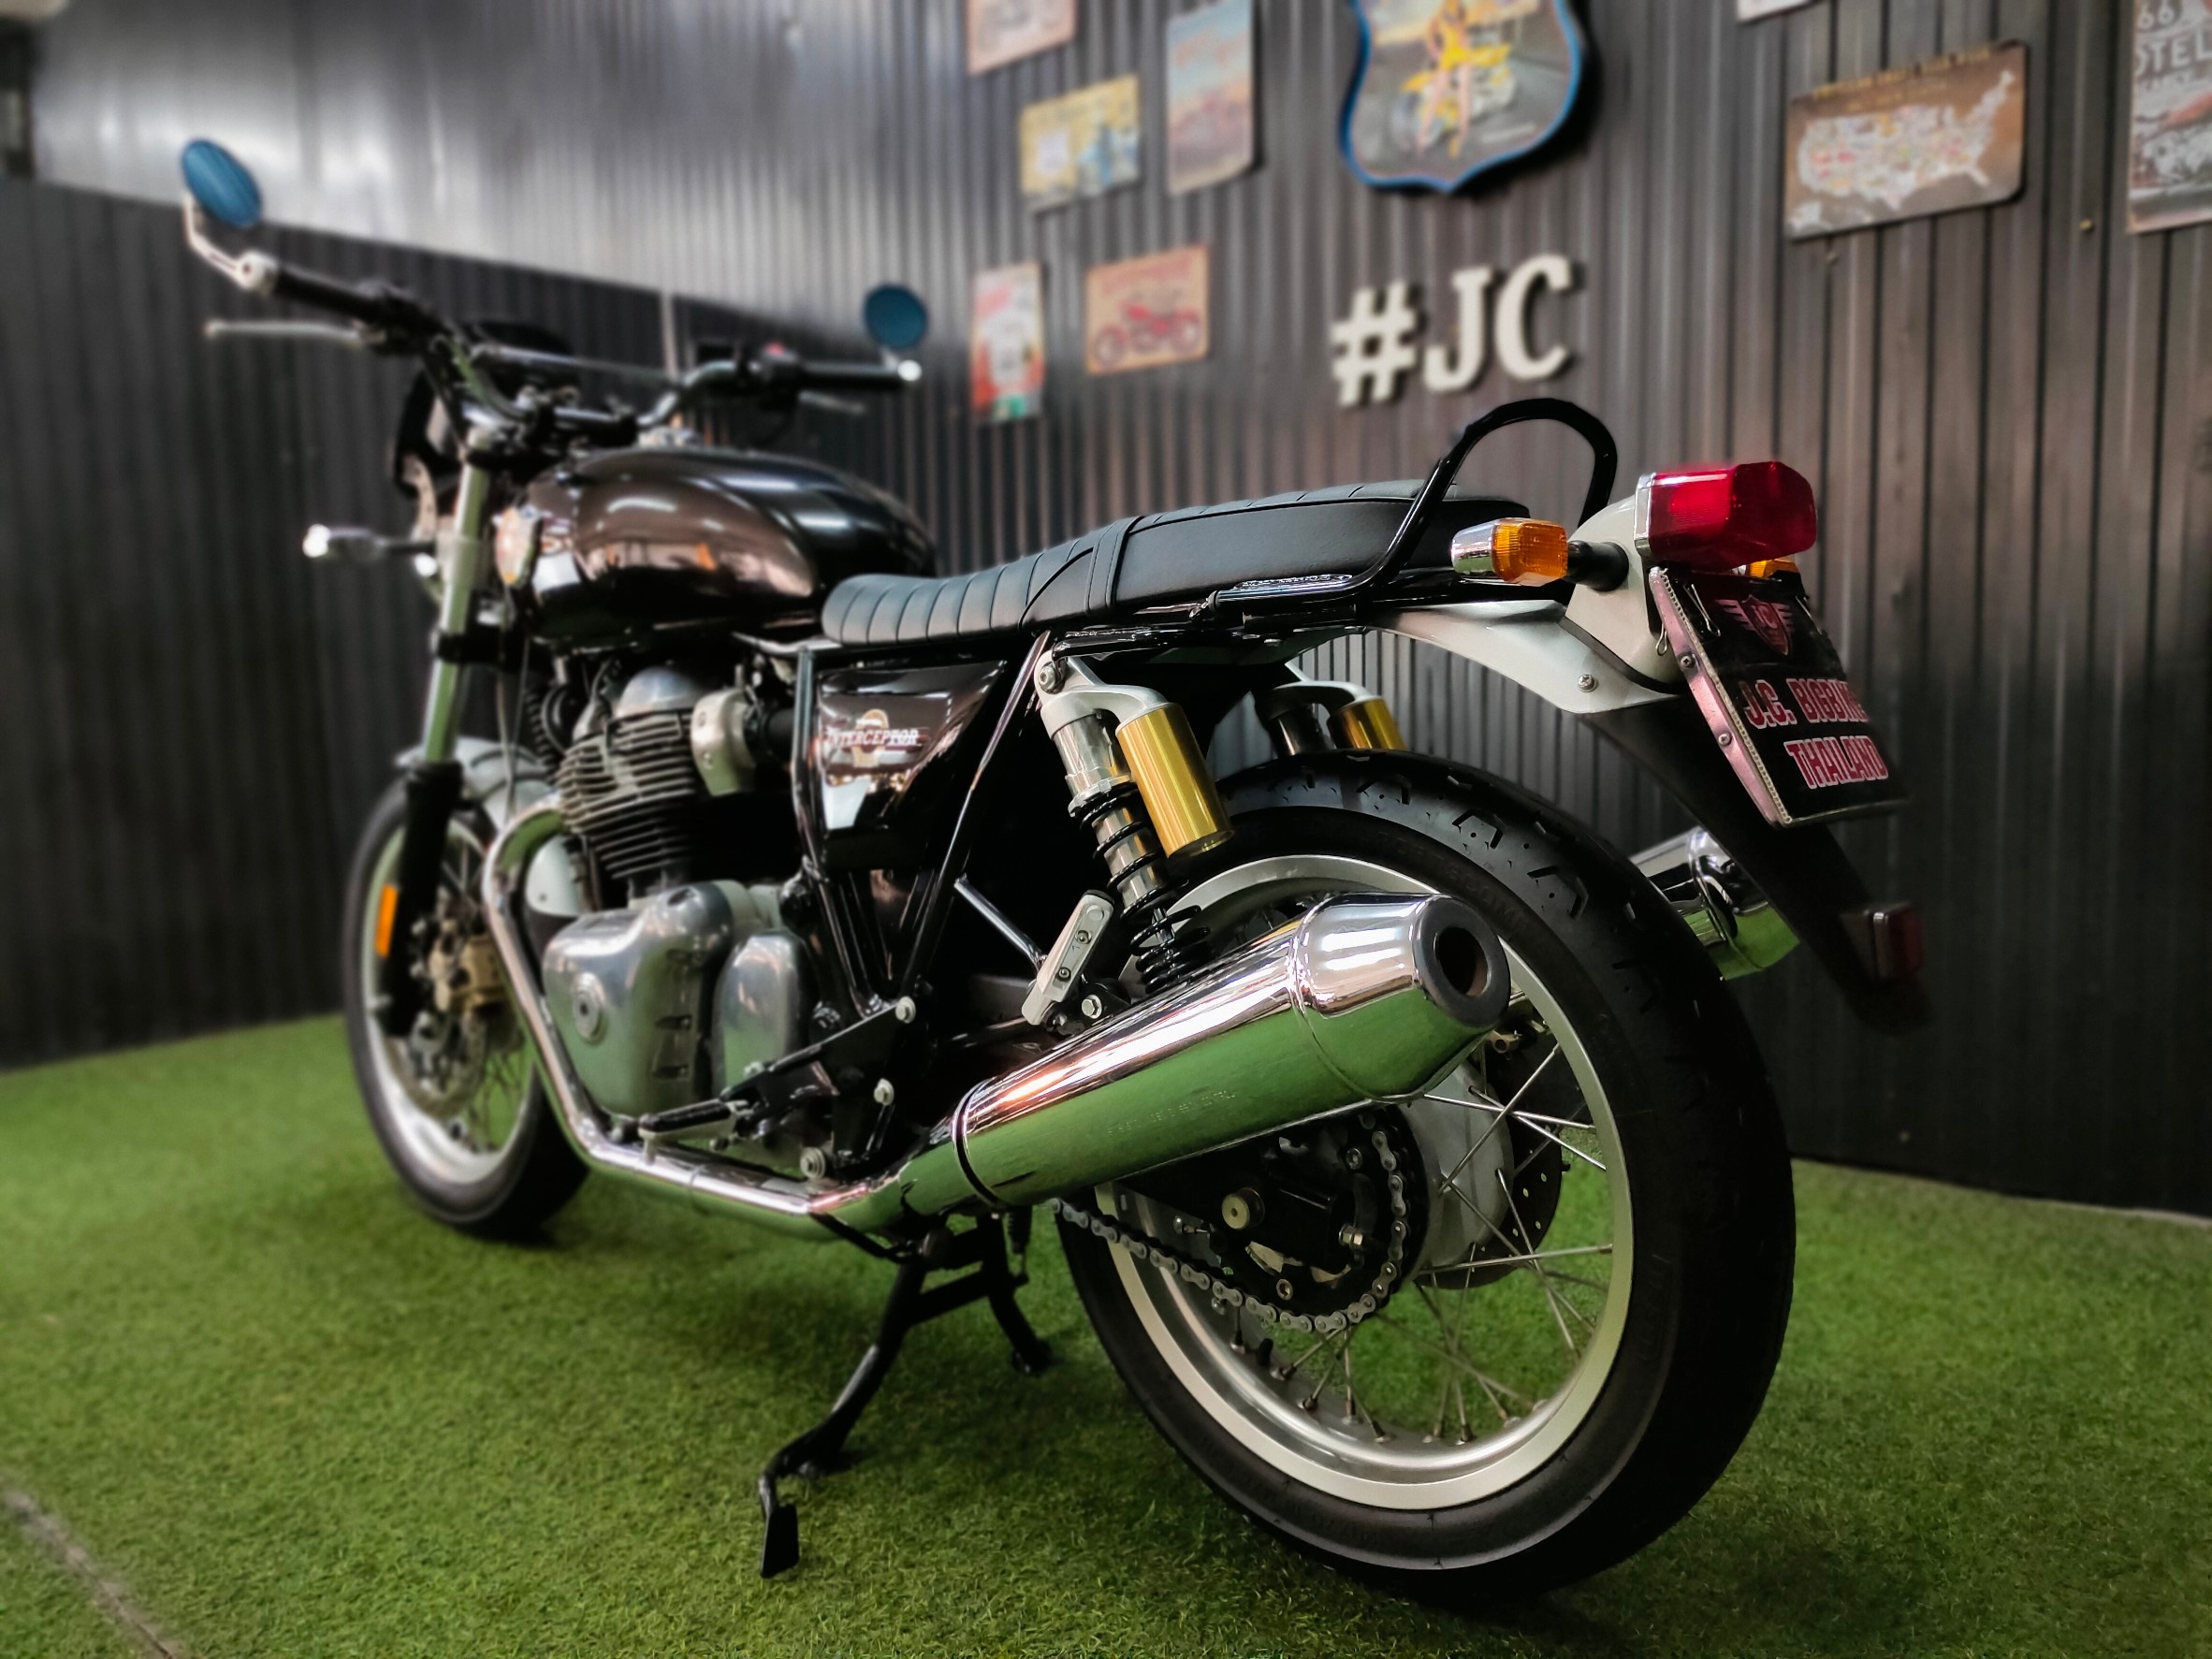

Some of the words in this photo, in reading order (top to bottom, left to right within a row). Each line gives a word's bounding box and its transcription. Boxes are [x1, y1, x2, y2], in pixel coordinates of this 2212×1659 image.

[1330, 252, 1572, 409] #JC
[1739, 679, 1797, 729] J.C.
[1783, 735, 1889, 790] THAILAND
